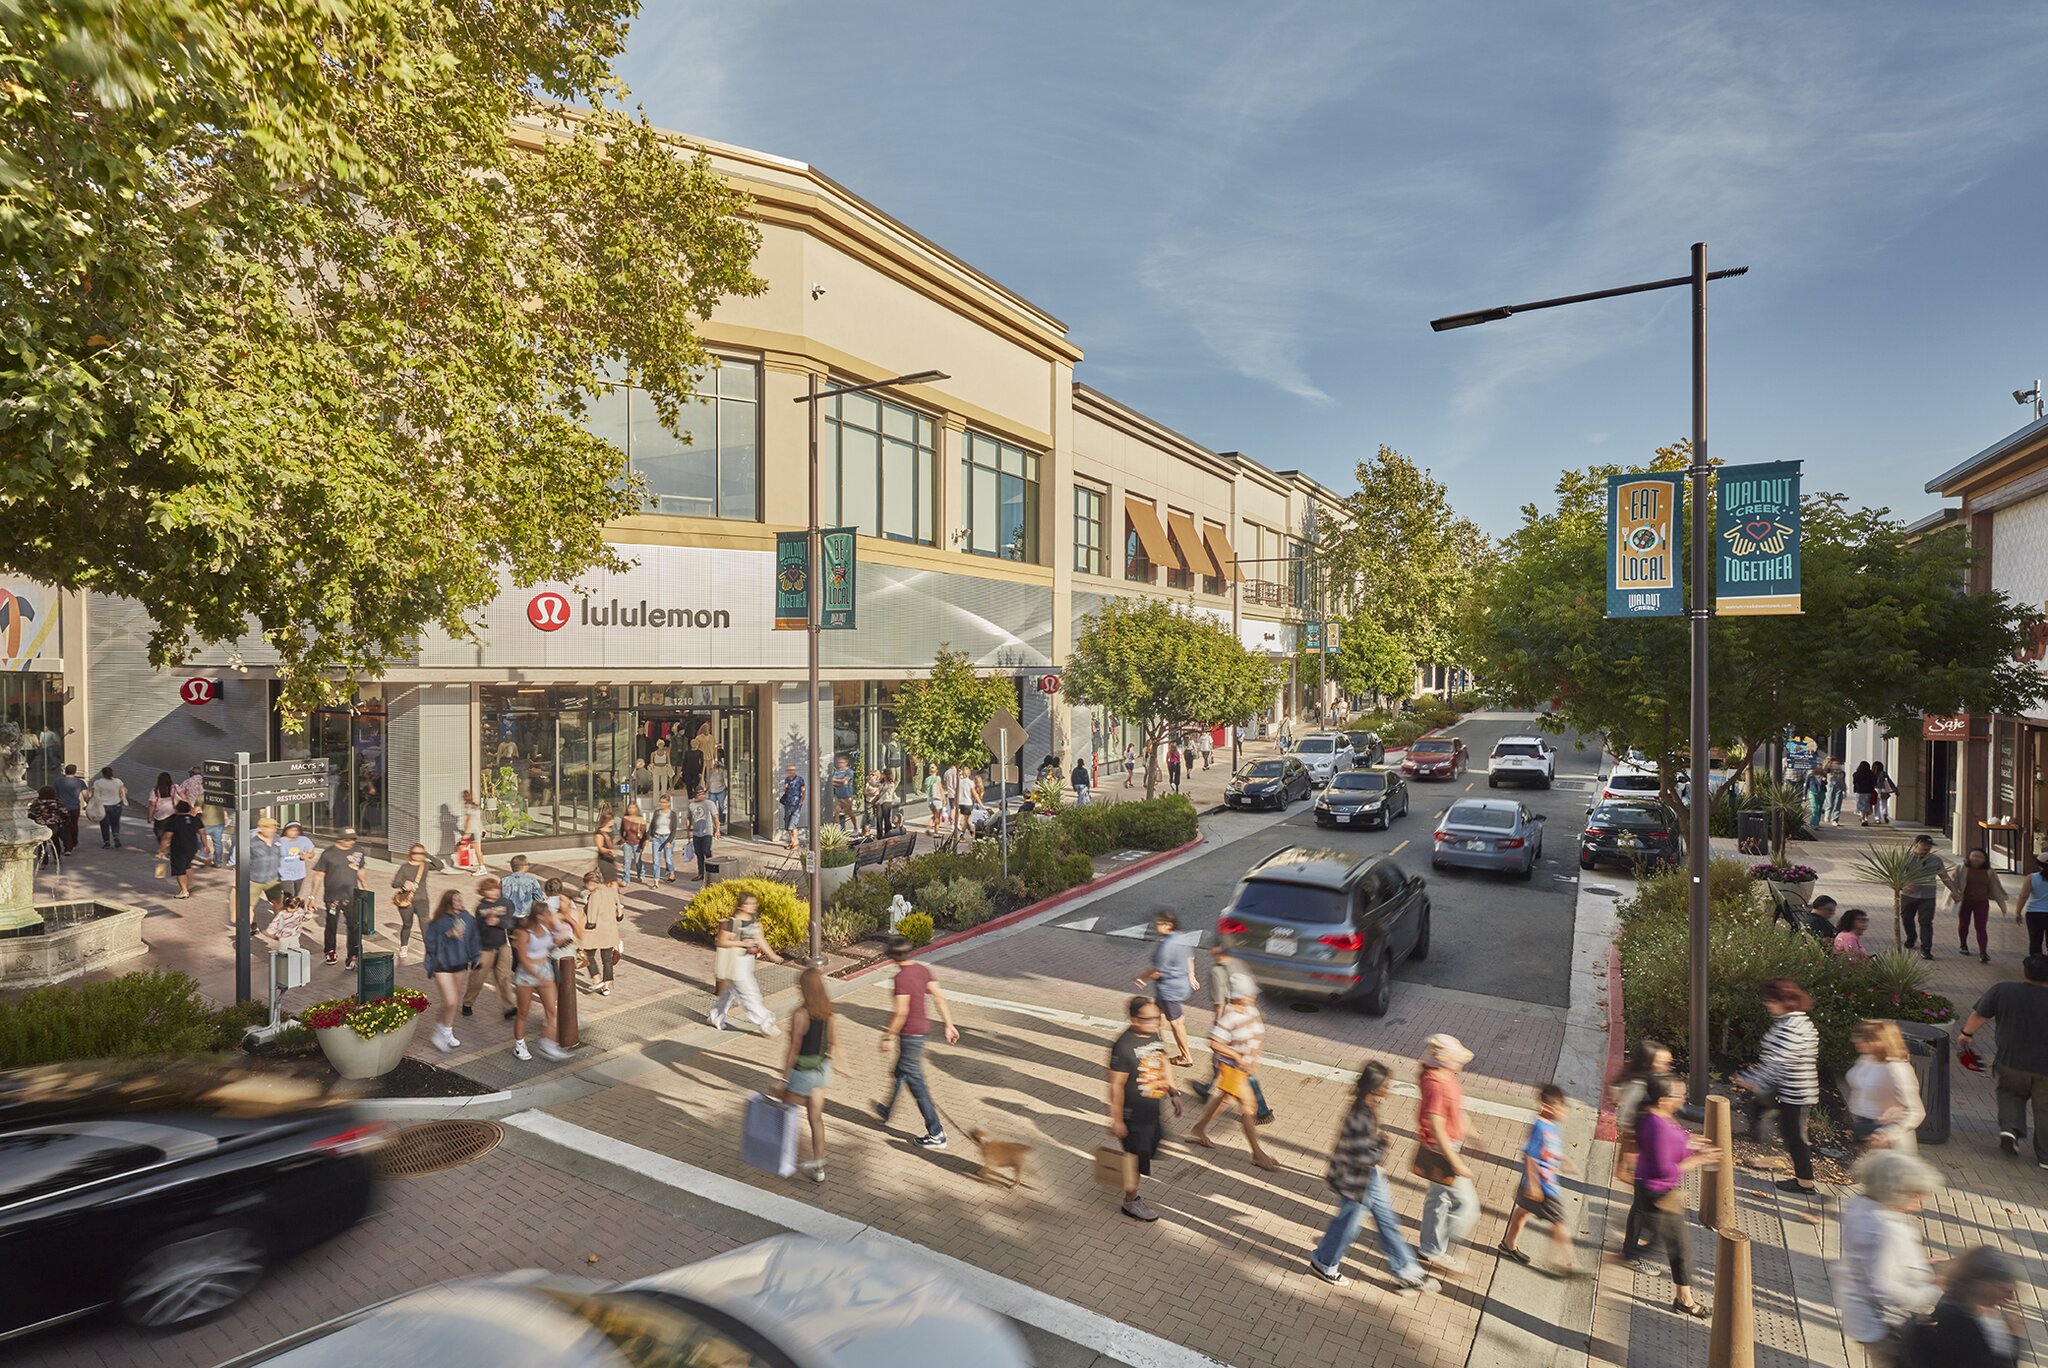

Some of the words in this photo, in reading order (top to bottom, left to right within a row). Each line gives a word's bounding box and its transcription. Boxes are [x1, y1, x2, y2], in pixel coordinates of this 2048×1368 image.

[1630, 488, 1660, 521] EAT
[1725, 478, 1792, 511] WALNUT
[1735, 504, 1781, 517] CREEK
[780, 541, 807, 562] WALNUT
[834, 539, 844, 561] BE
[1622, 555, 1667, 582] LOCAL
[1723, 553, 1793, 583] TOGETHER
[778, 589, 807, 609] TOGETHER
[829, 586, 850, 605] LOCAL
[1628, 593, 1661, 608] WALNUT
[581, 598, 731, 629] lululemon
[673, 697, 694, 706] 1210
[1928, 718, 1966, 732] Saje
[291, 763, 317, 771] MACY'S
[276, 793, 317, 802] RESTROOMS
